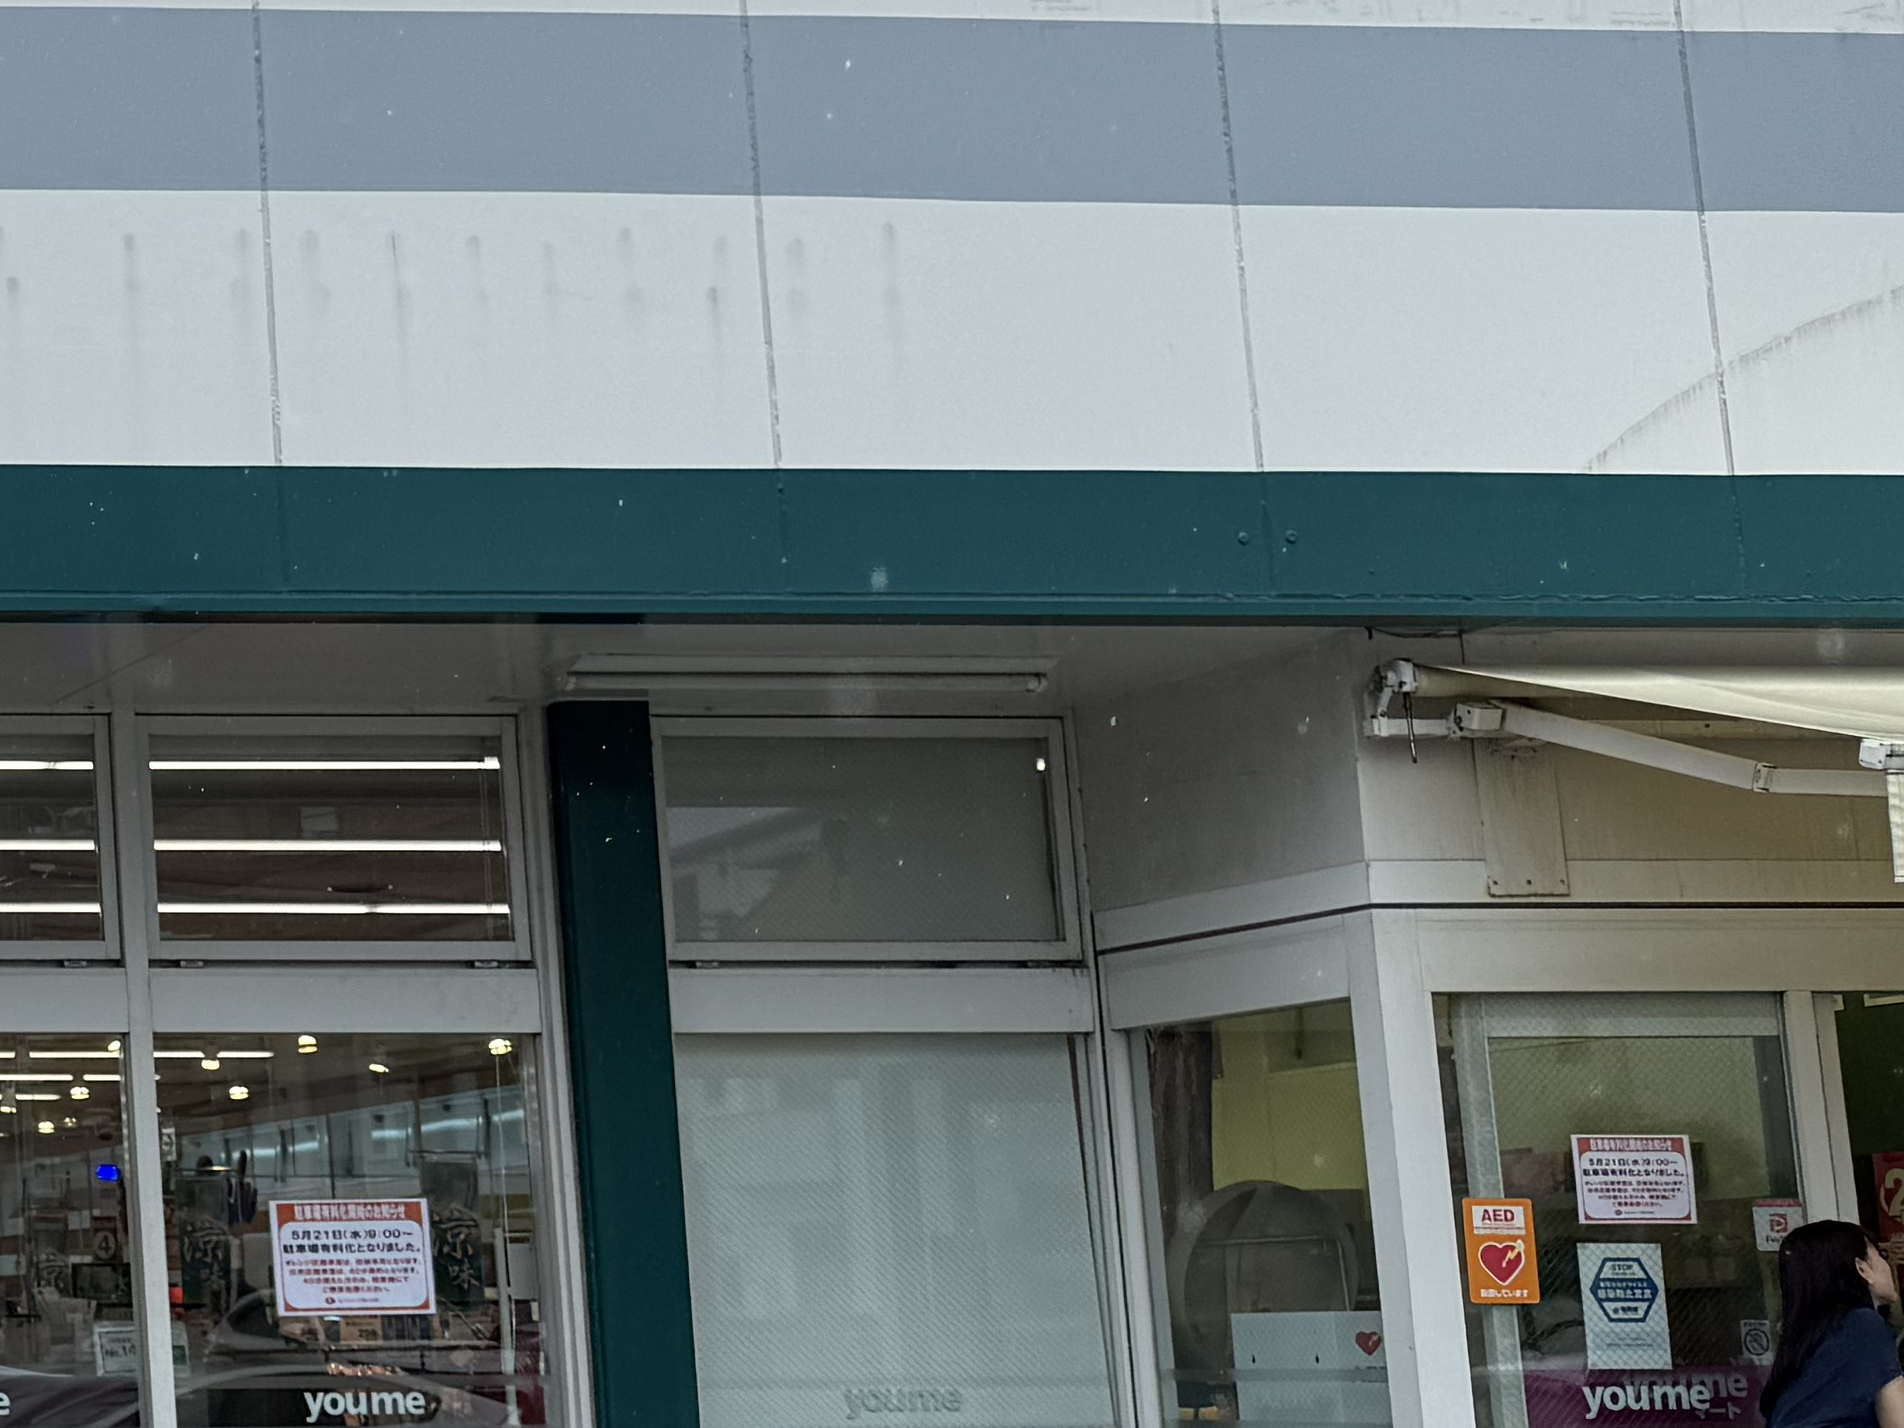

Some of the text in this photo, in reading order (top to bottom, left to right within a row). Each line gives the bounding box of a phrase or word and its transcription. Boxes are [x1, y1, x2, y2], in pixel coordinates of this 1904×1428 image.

[1481, 1208, 1515, 1223] AED
[282, 1241, 421, 1255] 駐車場有料化となりました。
[303, 1391, 426, 1424] youme
[843, 1387, 961, 1420] youme
[1580, 1384, 1712, 1420] youme
